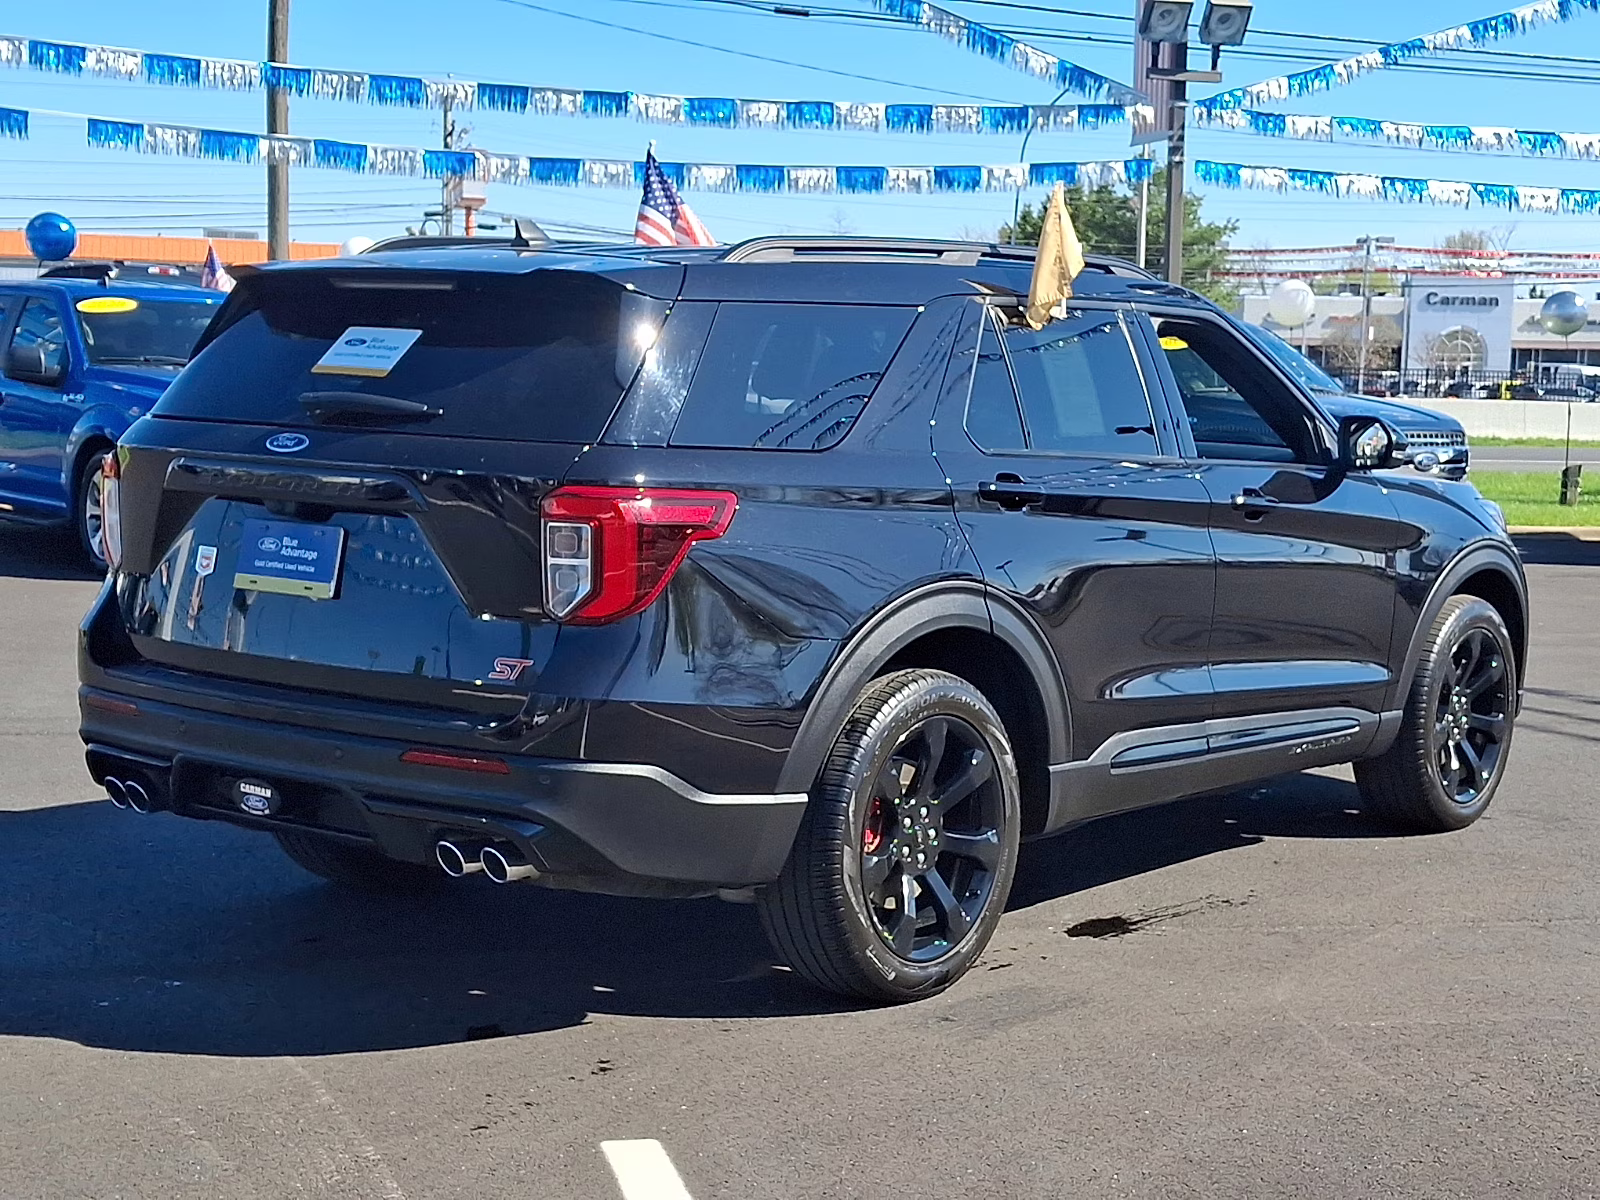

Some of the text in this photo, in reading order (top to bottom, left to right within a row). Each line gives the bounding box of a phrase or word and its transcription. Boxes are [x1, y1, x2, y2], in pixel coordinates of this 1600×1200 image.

[1426, 291, 1499, 307] Carman
[271, 432, 302, 448] Ford
[260, 536, 299, 550] Ford Blue
[280, 546, 318, 560] Advantage
[266, 560, 284, 569] Certified
[284, 562, 297, 570] Used
[297, 564, 315, 573] Vehicle
[488, 657, 534, 680] ST
